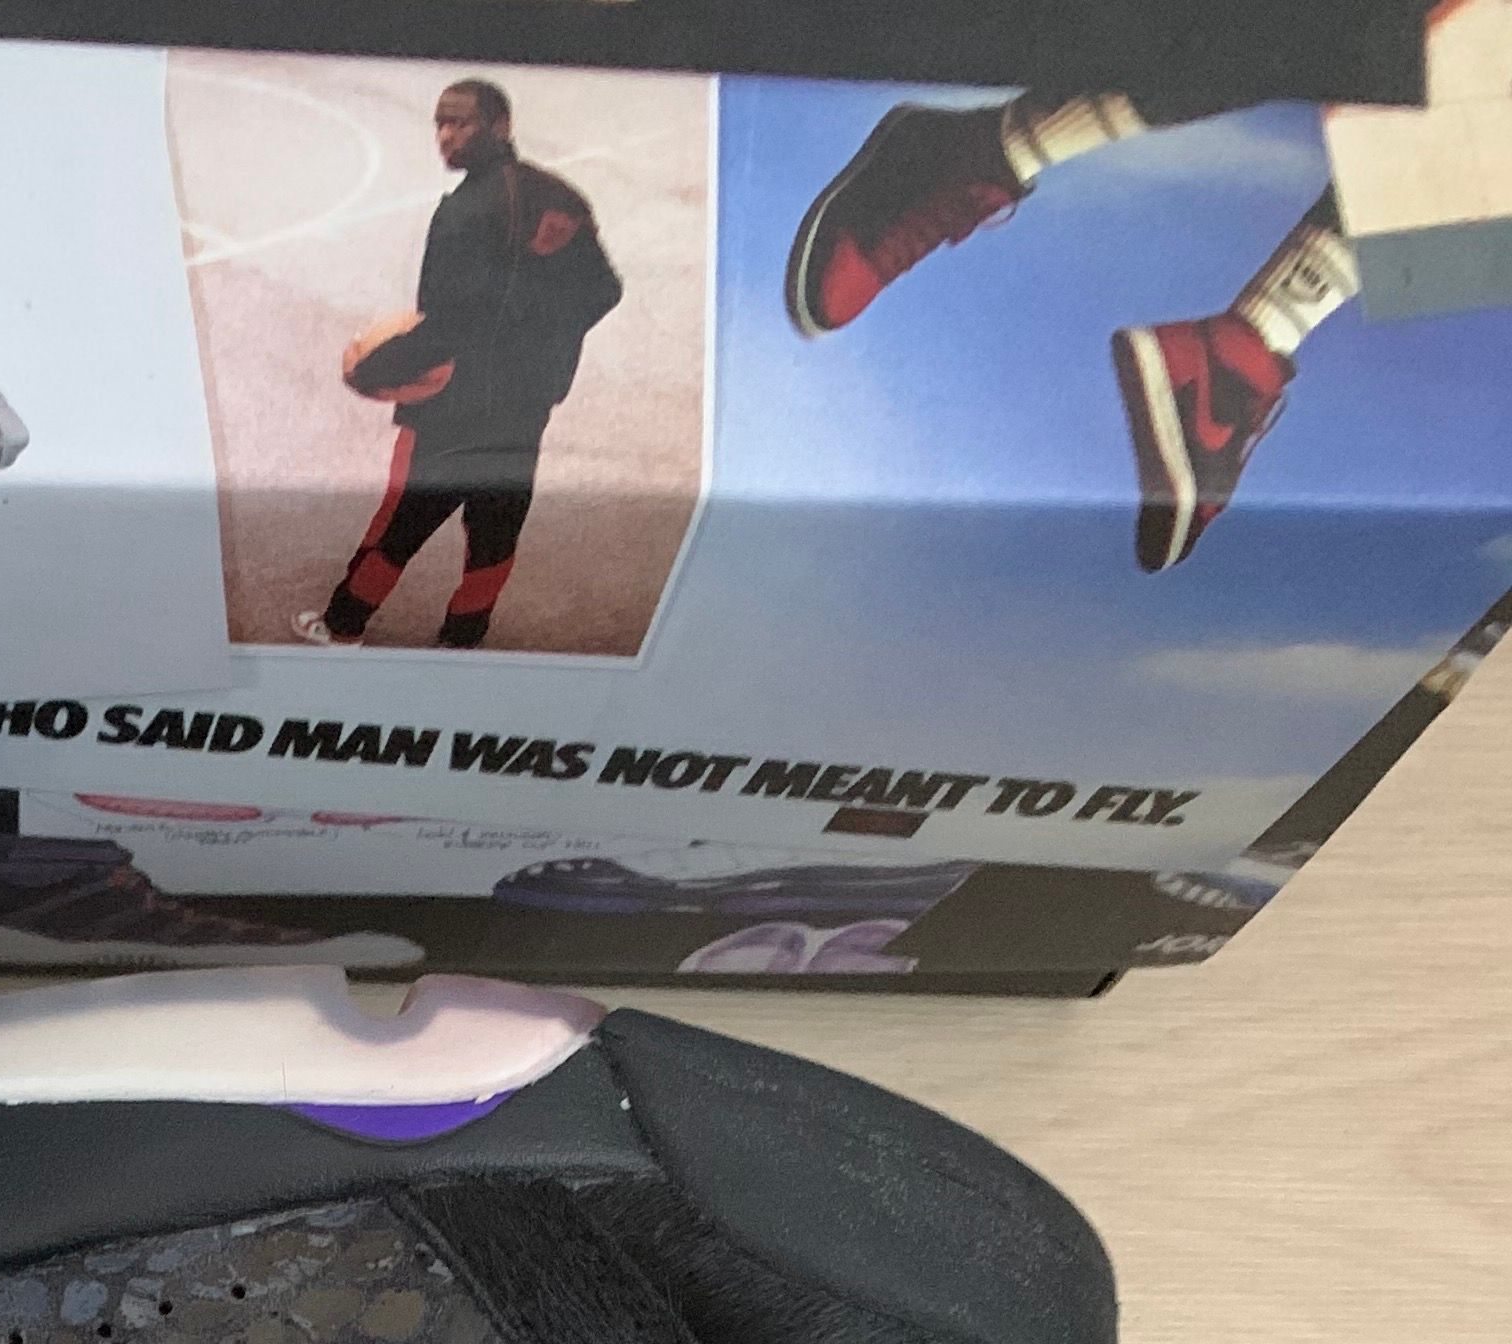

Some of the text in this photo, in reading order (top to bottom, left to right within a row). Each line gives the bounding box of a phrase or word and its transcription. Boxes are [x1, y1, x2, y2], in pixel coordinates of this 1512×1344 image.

[96, 704, 264, 754] SAID
[267, 718, 442, 769] MAN
[449, 729, 595, 781] WAS
[596, 745, 750, 793] NOT
[740, 758, 990, 812] MEANT
[985, 775, 1078, 818] TO
[1072, 783, 1202, 826] FLY.
